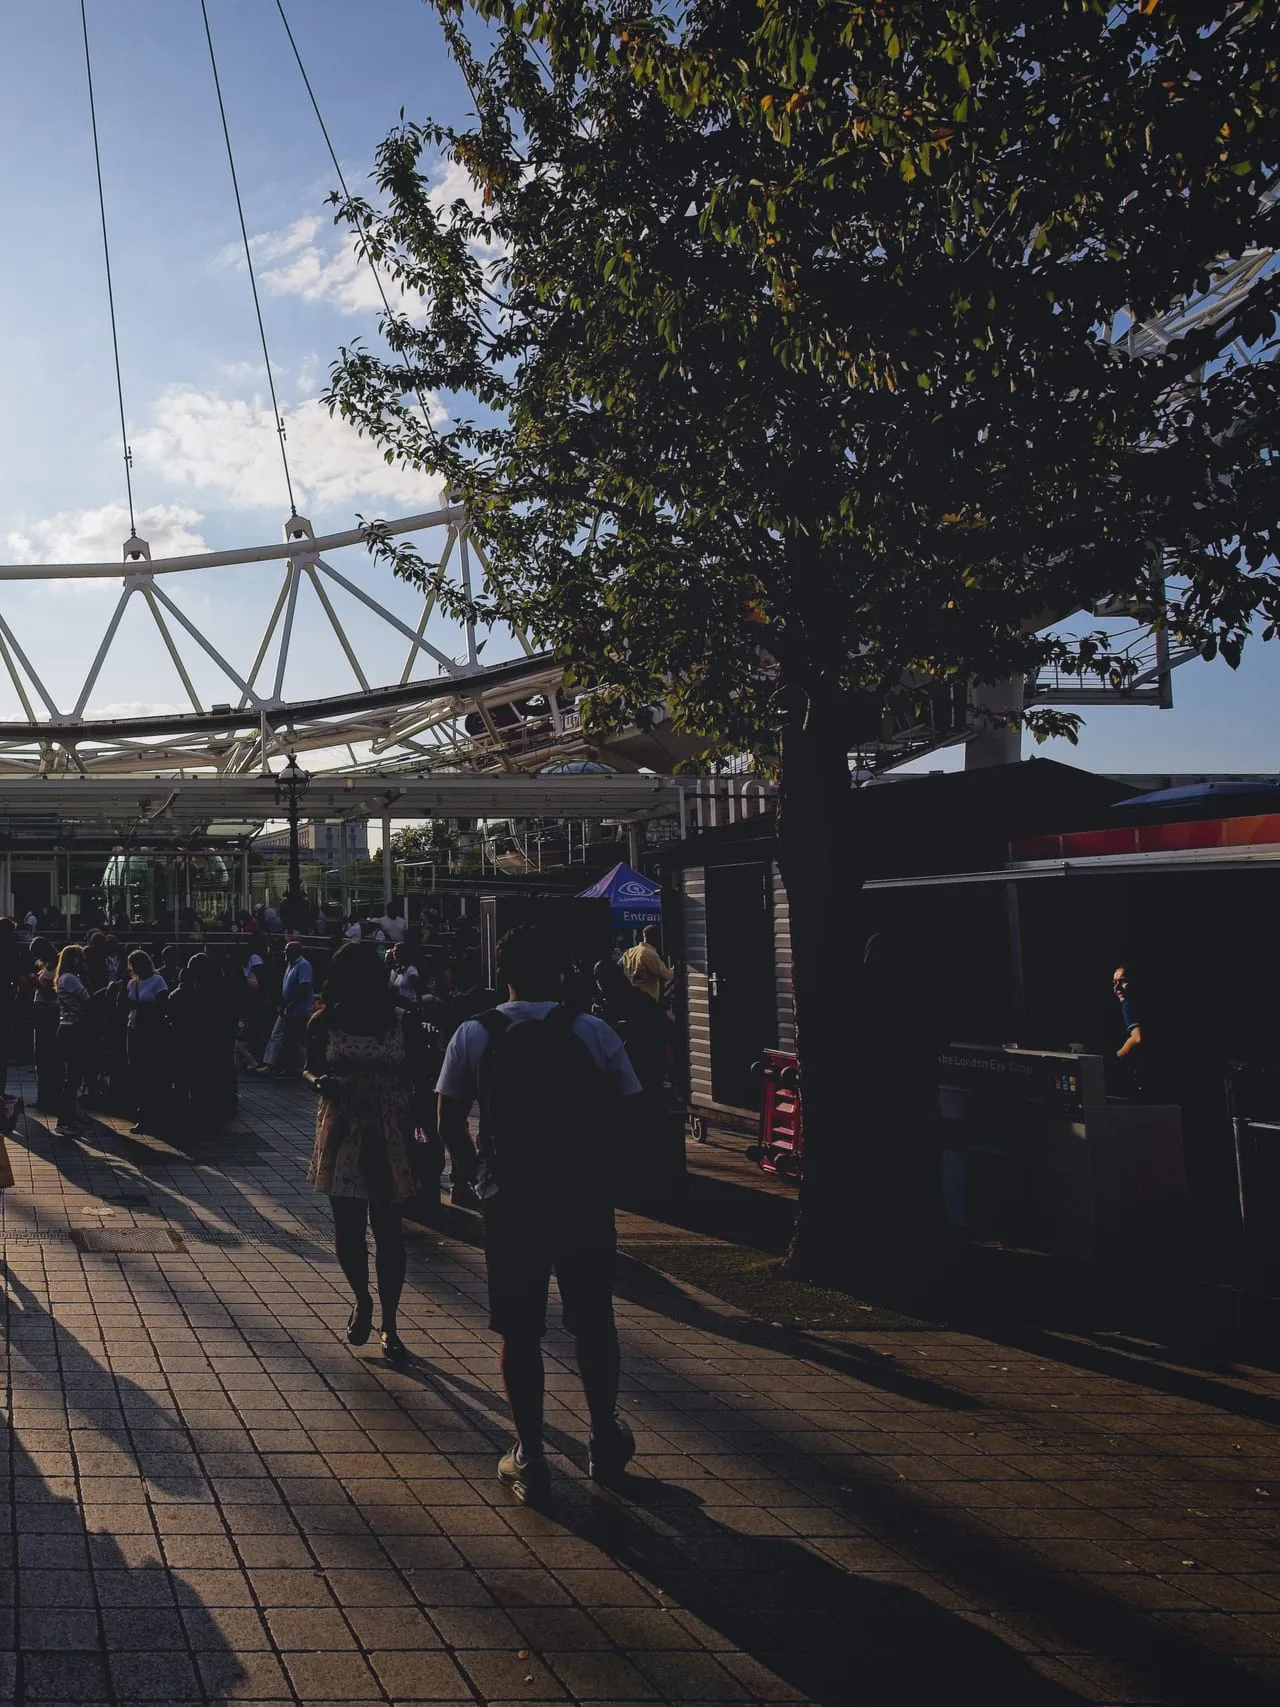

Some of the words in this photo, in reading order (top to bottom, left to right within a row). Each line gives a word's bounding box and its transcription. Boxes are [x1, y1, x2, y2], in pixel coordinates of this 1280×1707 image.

[623, 911, 660, 922] Entran
[955, 1055, 989, 1069] London
[990, 1059, 1007, 1073] Eye
